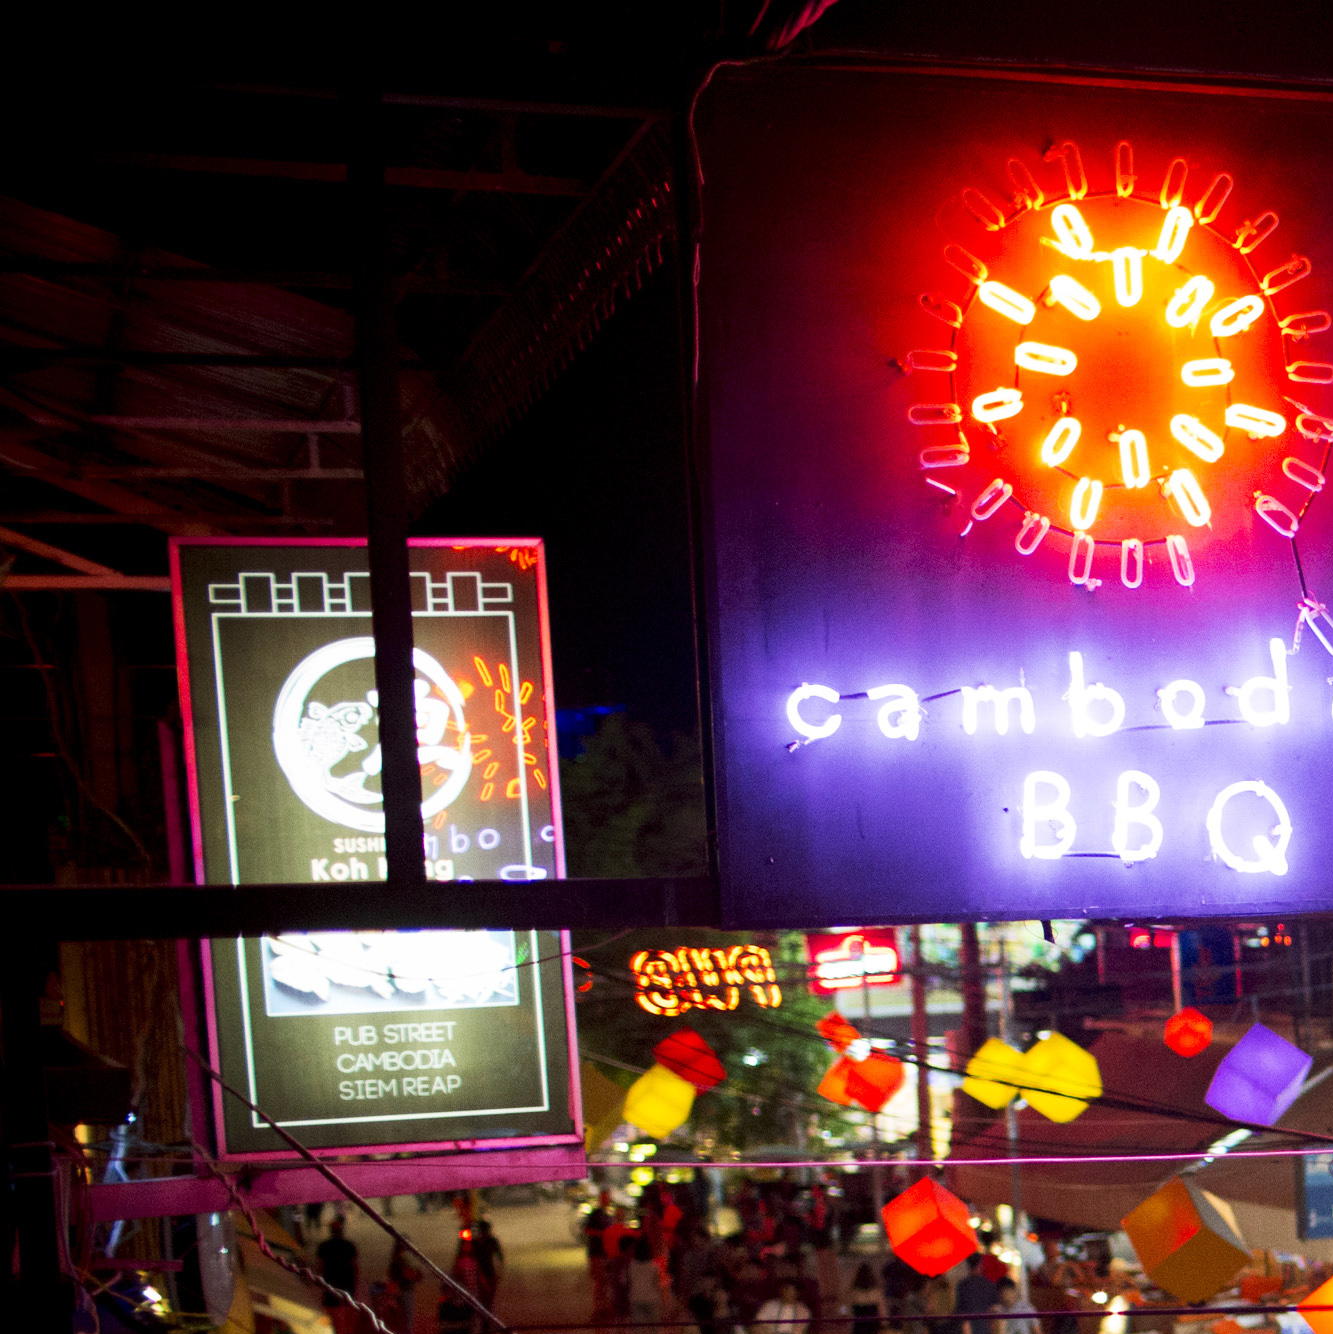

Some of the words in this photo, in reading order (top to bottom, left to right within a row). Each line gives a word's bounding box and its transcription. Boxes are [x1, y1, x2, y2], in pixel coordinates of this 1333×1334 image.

[1021, 770, 1293, 877] BBQ
[311, 858, 369, 881] Koh
[334, 1026, 378, 1046] PUB
[383, 1021, 457, 1045] STREET
[336, 1048, 457, 1073] CAMBODIA
[339, 1079, 398, 1100] SIEM
[403, 1075, 462, 1097] REAP
